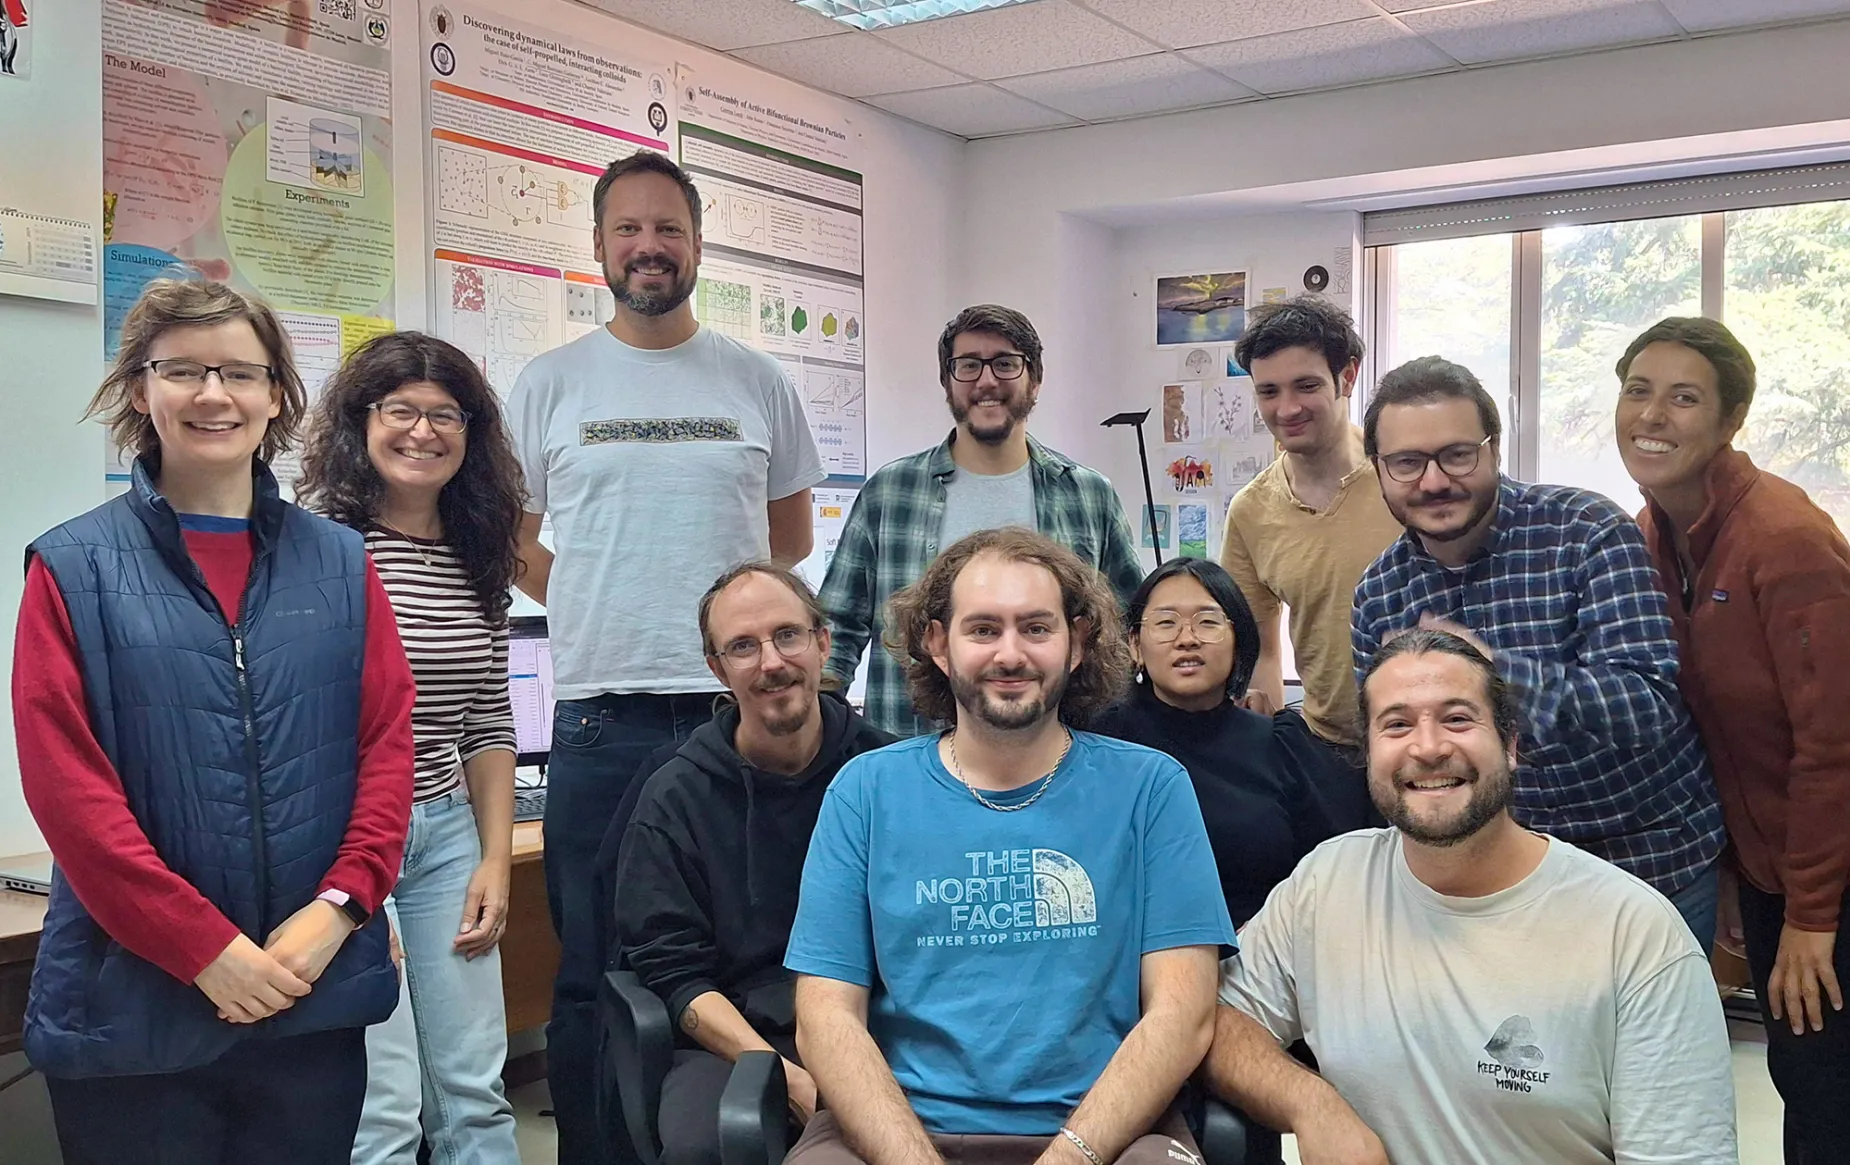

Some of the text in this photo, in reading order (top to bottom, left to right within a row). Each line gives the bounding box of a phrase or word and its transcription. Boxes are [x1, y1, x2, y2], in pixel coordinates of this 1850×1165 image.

[463, 15, 515, 42] Discovering
[516, 31, 557, 52] dynamical
[558, 43, 576, 58] laws
[577, 49, 595, 64] from
[595, 56, 642, 79] observations:
[483, 34, 495, 44] the
[496, 38, 511, 49] case
[511, 43, 519, 51] of
[519, 45, 568, 67] self-propelled,
[568, 58, 602, 78] interacting
[602, 69, 627, 84] colloids
[105, 54, 166, 78] The Model
[698, 86, 739, 108] Self-Assembly
[740, 100, 748, 109] of
[748, 102, 766, 115] Active
[766, 107, 800, 125] Bifunctional
[800, 118, 825, 135] Brownian
[825, 126, 846, 141] Particles
[285, 189, 350, 209] Experiments
[965, 849, 1031, 876] THE
[916, 874, 1032, 904] NORTH
[951, 901, 1034, 931] FACE
[917, 935, 964, 947] NEVER
[970, 932, 1008, 945] STOP
[1477, 1060, 1551, 1084] KEEP YOURSELF
[1495, 1078, 1532, 1093] MOVING
